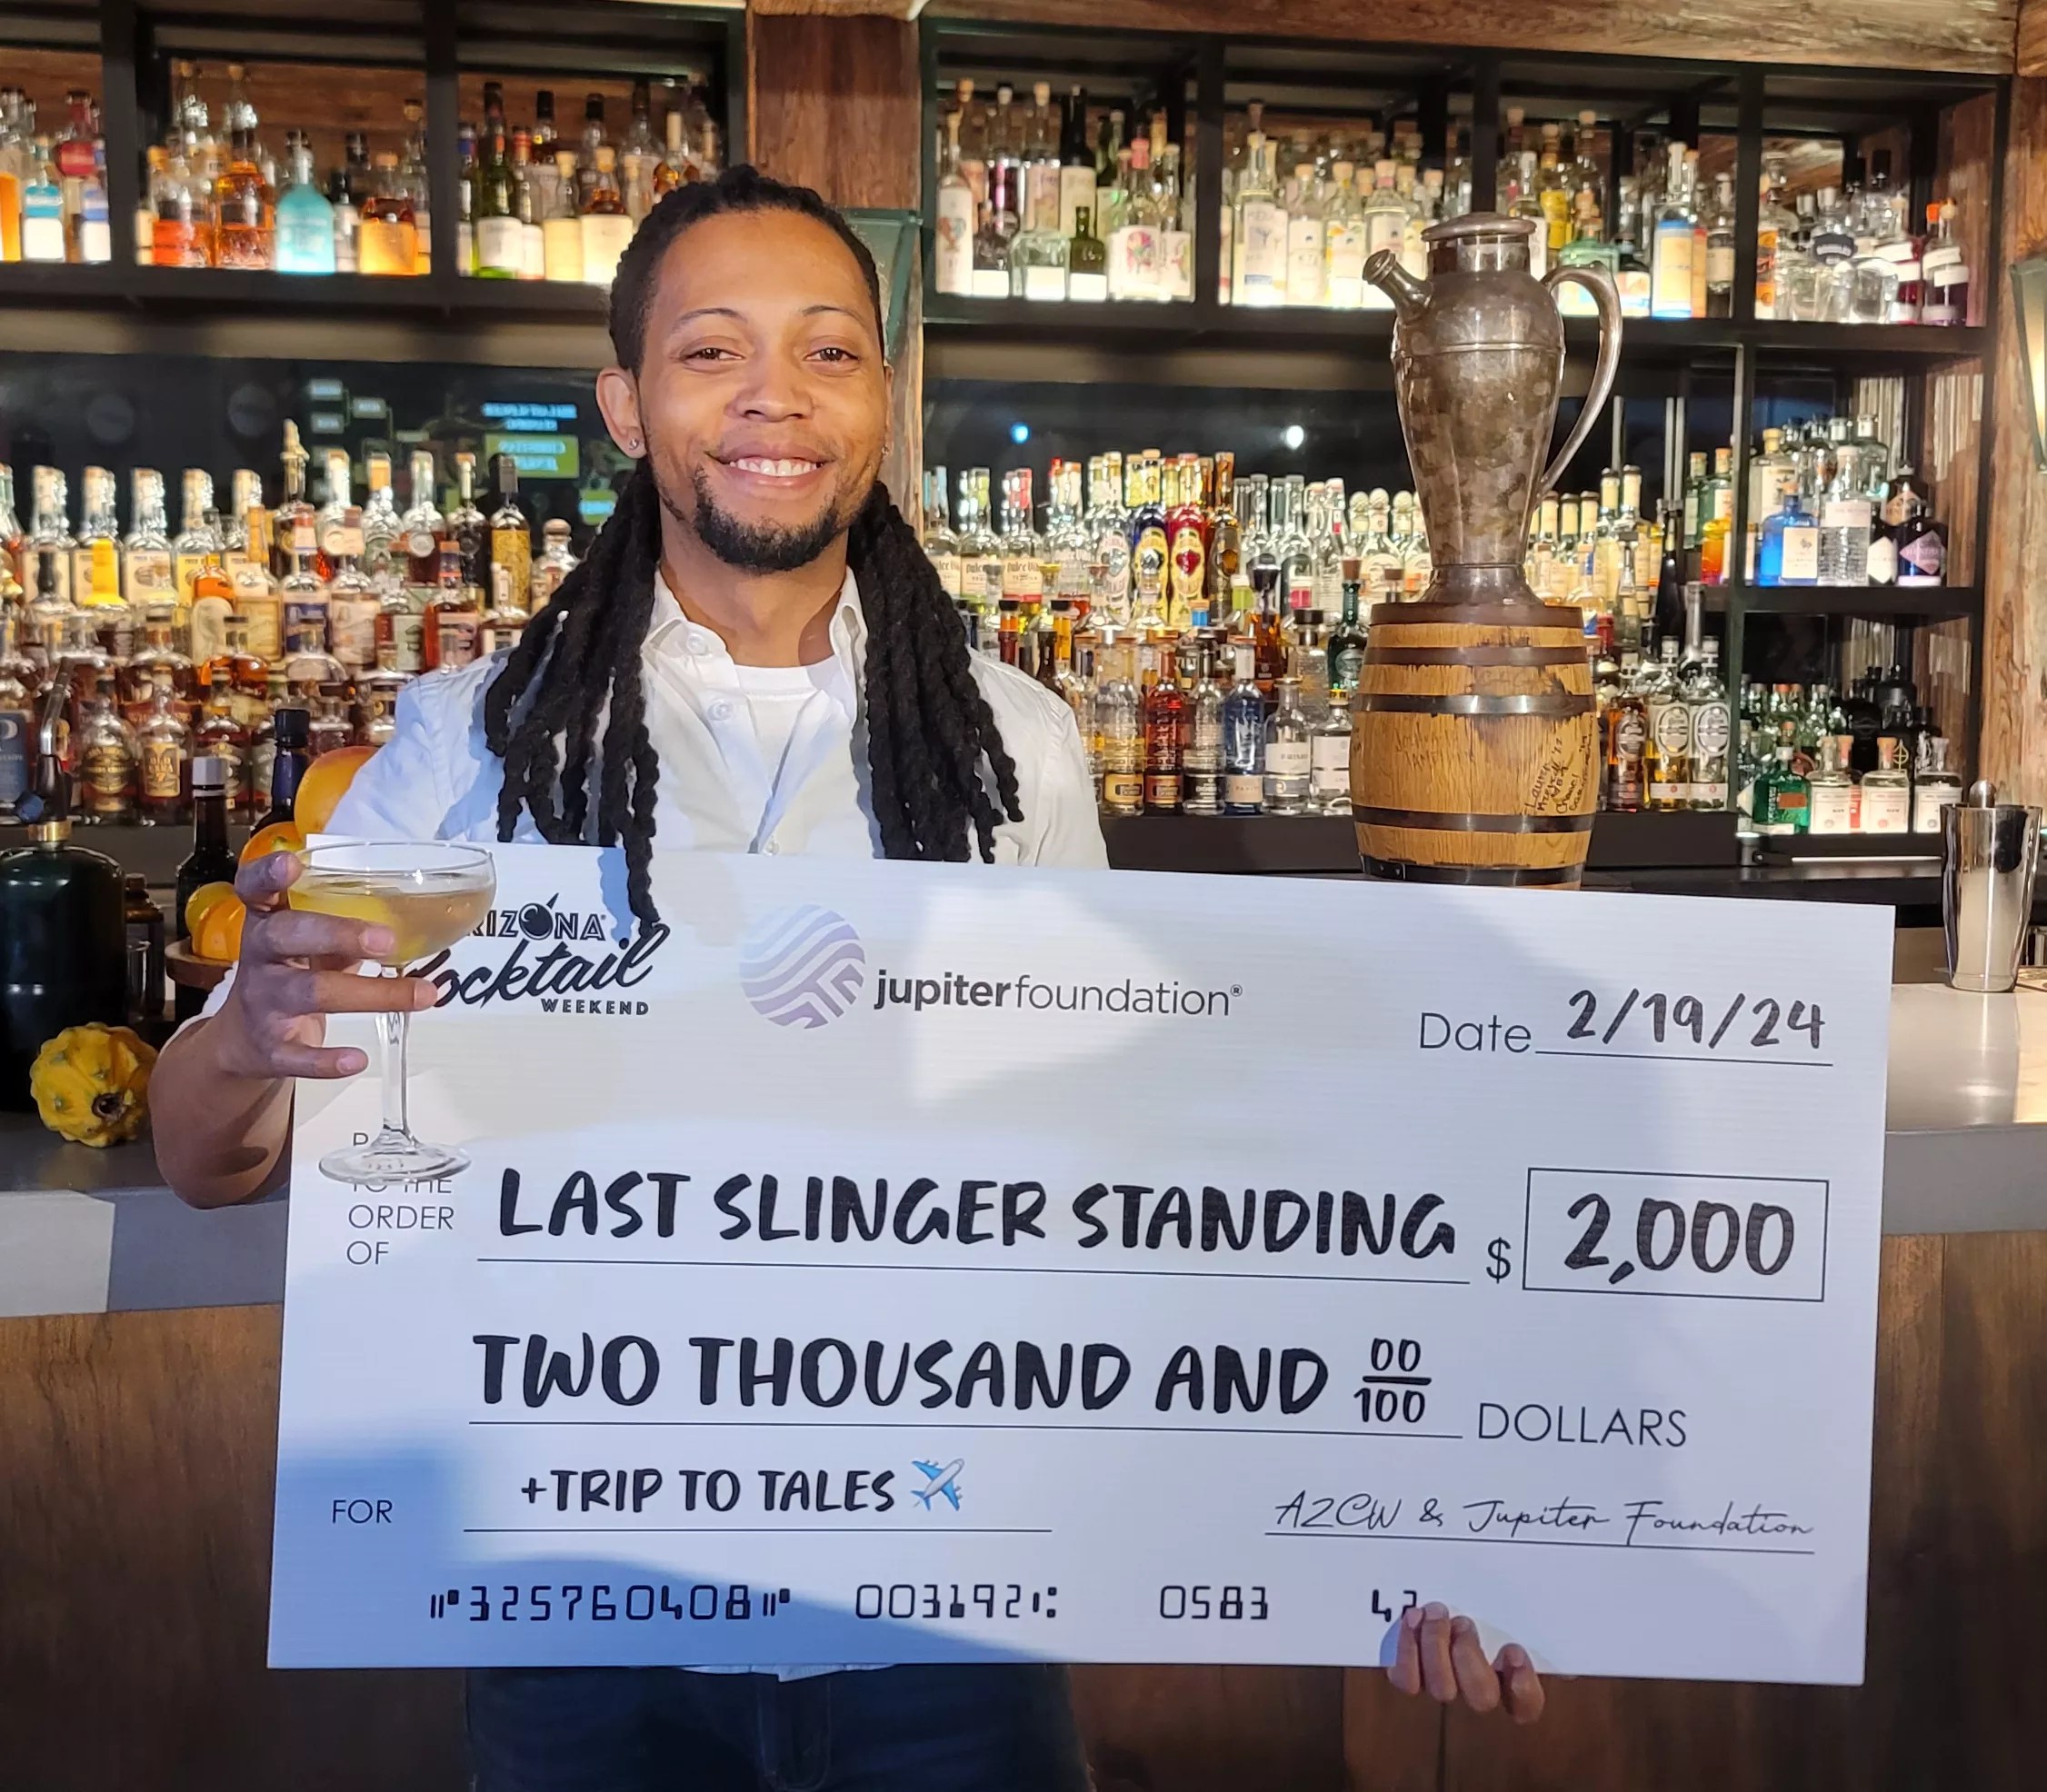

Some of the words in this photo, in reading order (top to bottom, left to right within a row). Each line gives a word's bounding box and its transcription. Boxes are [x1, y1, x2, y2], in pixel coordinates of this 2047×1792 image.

[466, 896, 602, 941] IZONA
[541, 999, 649, 1015] WEEKEND
[1420, 1012, 1532, 1053] Date
[1567, 988, 1825, 1049] 2/19/24
[348, 1205, 454, 1230] ORDER
[500, 1168, 691, 1238] LAST
[714, 1173, 1046, 1246] SLINGER
[1073, 1182, 1455, 1259] STANDING
[346, 1240, 389, 1264] OF
[1486, 1237, 1511, 1284] $
[1564, 1193, 1794, 1285] 2,000
[473, 1332, 660, 1408] TWO
[689, 1337, 1131, 1410] THOUSAND
[1155, 1345, 1328, 1415] AND
[1479, 1402, 1687, 1447] DOLLARS
[332, 1499, 393, 1524] FOR
[522, 1468, 663, 1513] +TRIP
[679, 1469, 741, 1512] TO
[758, 1469, 895, 1512] TALES
[1419, 1498, 1443, 1527] &
[1462, 1497, 1610, 1537] Jupiter
[1624, 1500, 1812, 1545] Foundation
[1160, 1586, 1268, 1620] 0583
